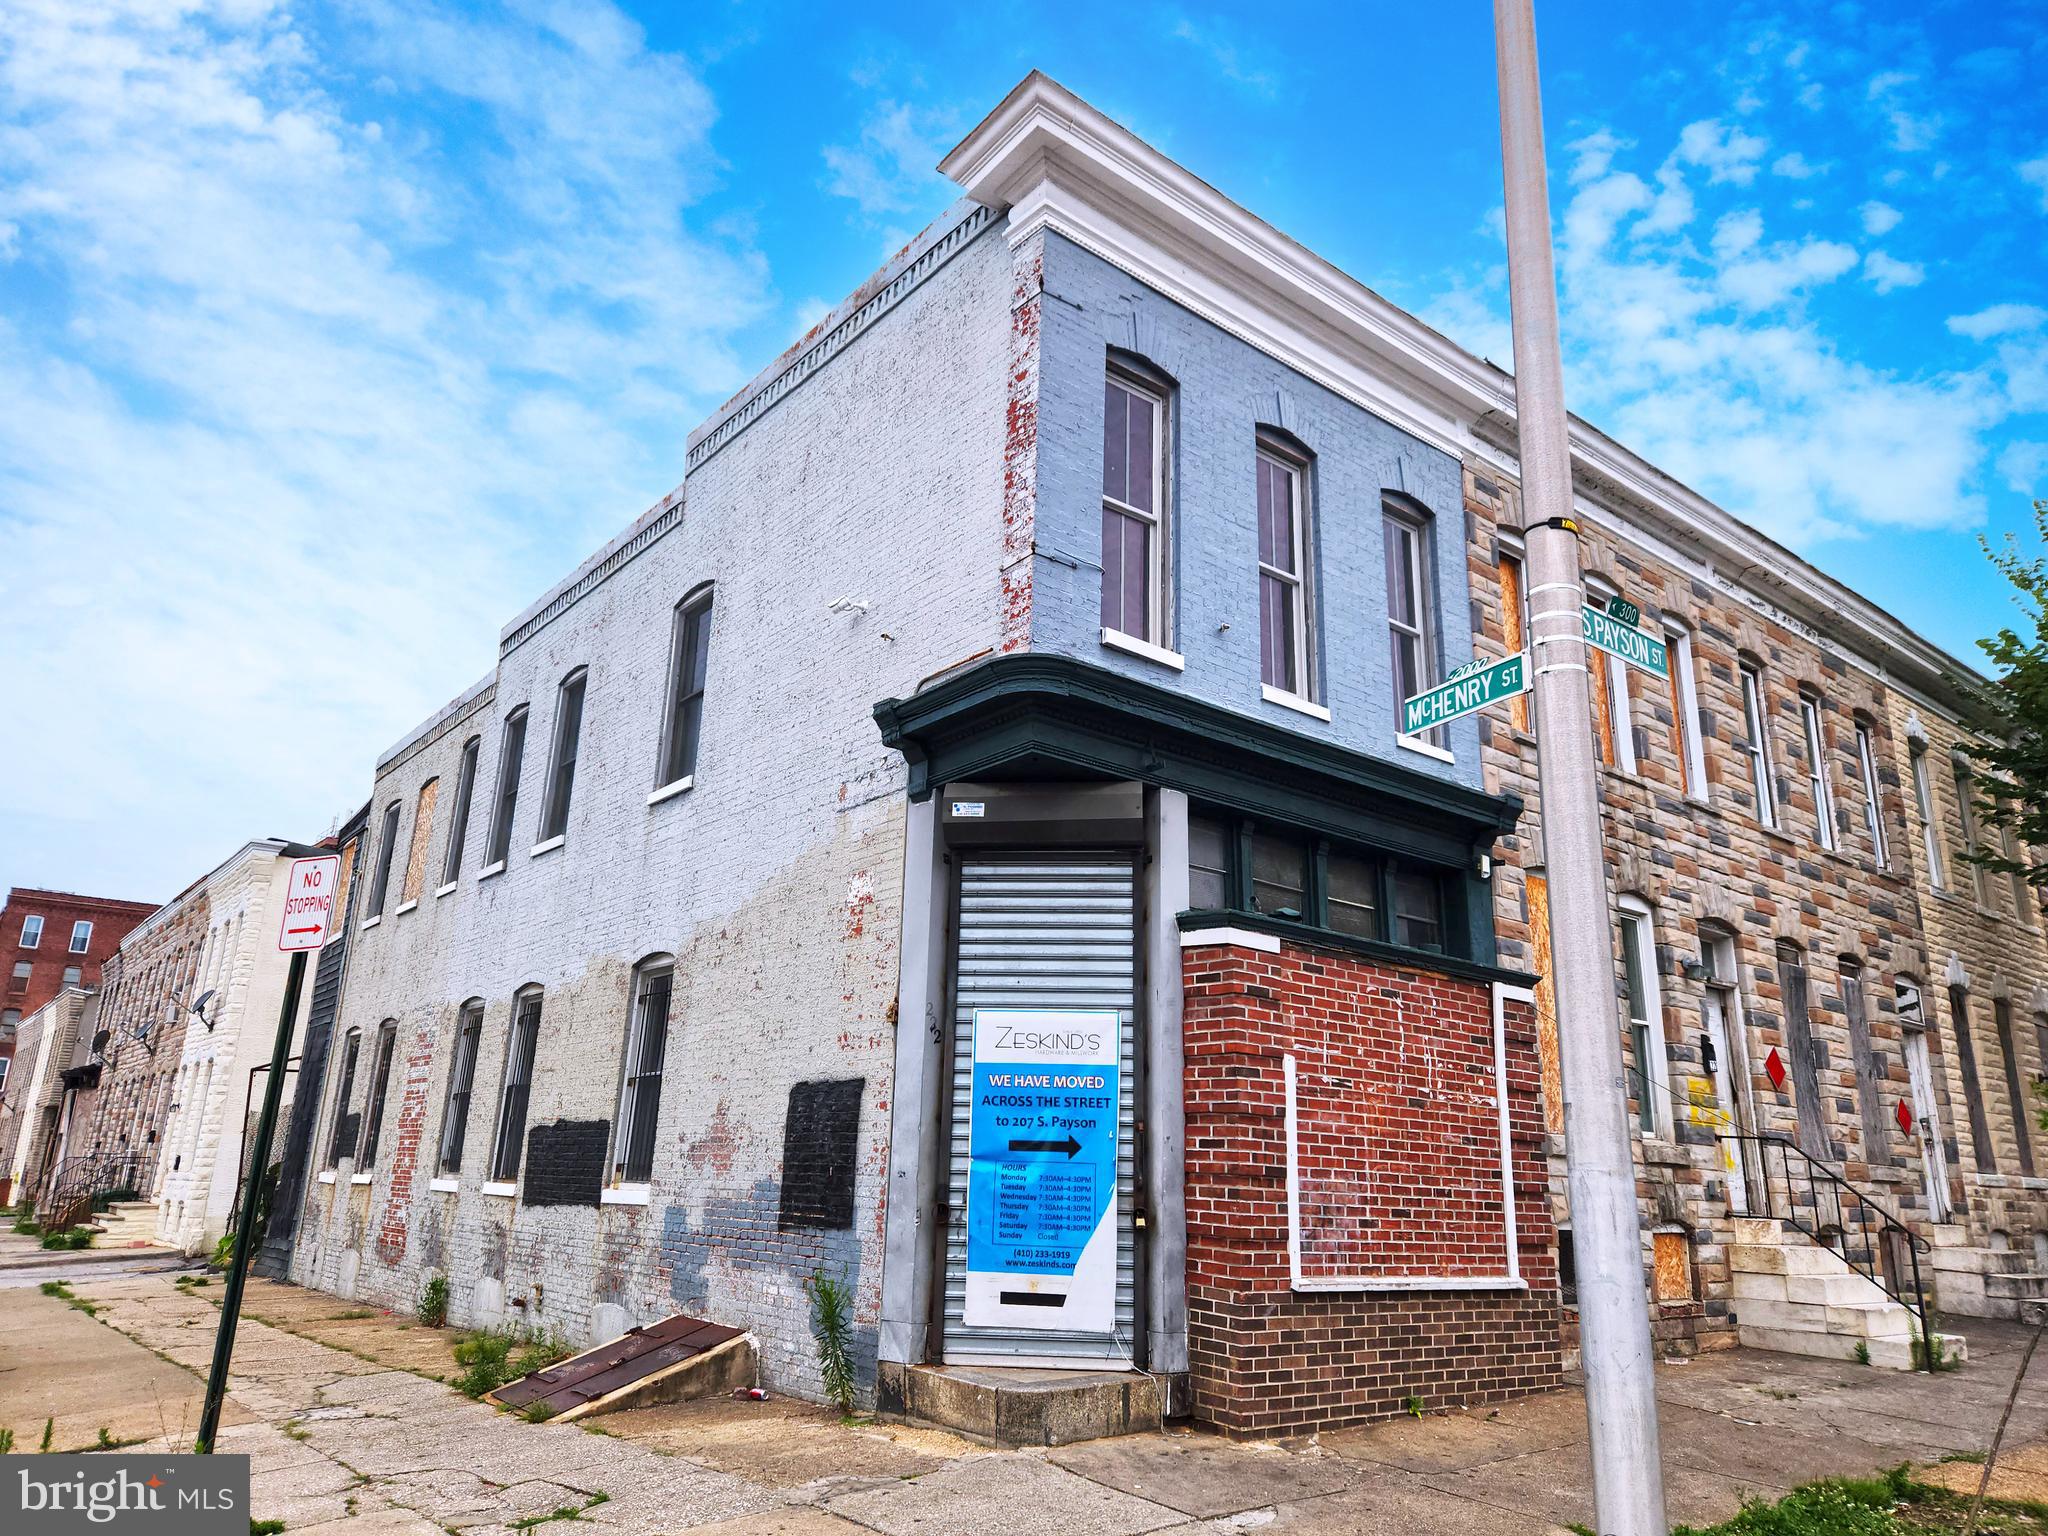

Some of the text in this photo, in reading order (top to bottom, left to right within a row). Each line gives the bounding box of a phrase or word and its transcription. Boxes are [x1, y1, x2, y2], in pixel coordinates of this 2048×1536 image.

[1620, 603, 1637, 623] 300
[1594, 614, 1650, 665] PAYSON
[1652, 647, 1664, 667] ST.
[1452, 657, 1488, 680] 2000
[1501, 666, 1518, 687] ST.
[303, 871, 322, 888] NO
[287, 895, 330, 915] STOPPING
[995, 1026, 1101, 1050] ZESKIND'S
[988, 1074, 1105, 1089] WE HAVE MOVED
[982, 1095, 1112, 1109] ACROSS THE STREET
[996, 1116, 1097, 1131] to 207 S. Payson
[1002, 1163, 1027, 1172] HOURS
[1001, 1173, 1027, 1182] Monday
[1001, 1183, 1026, 1192] Tuesday
[1000, 1193, 1037, 1201] Wednesday
[1000, 1202, 1029, 1211] Thursday
[1000, 1212, 1019, 1220] Friday
[999, 1221, 1028, 1230] Saturday
[999, 1231, 1059, 1240] Sunday Closed
[1013, 1249, 1071, 1259] (410) 233-1919
